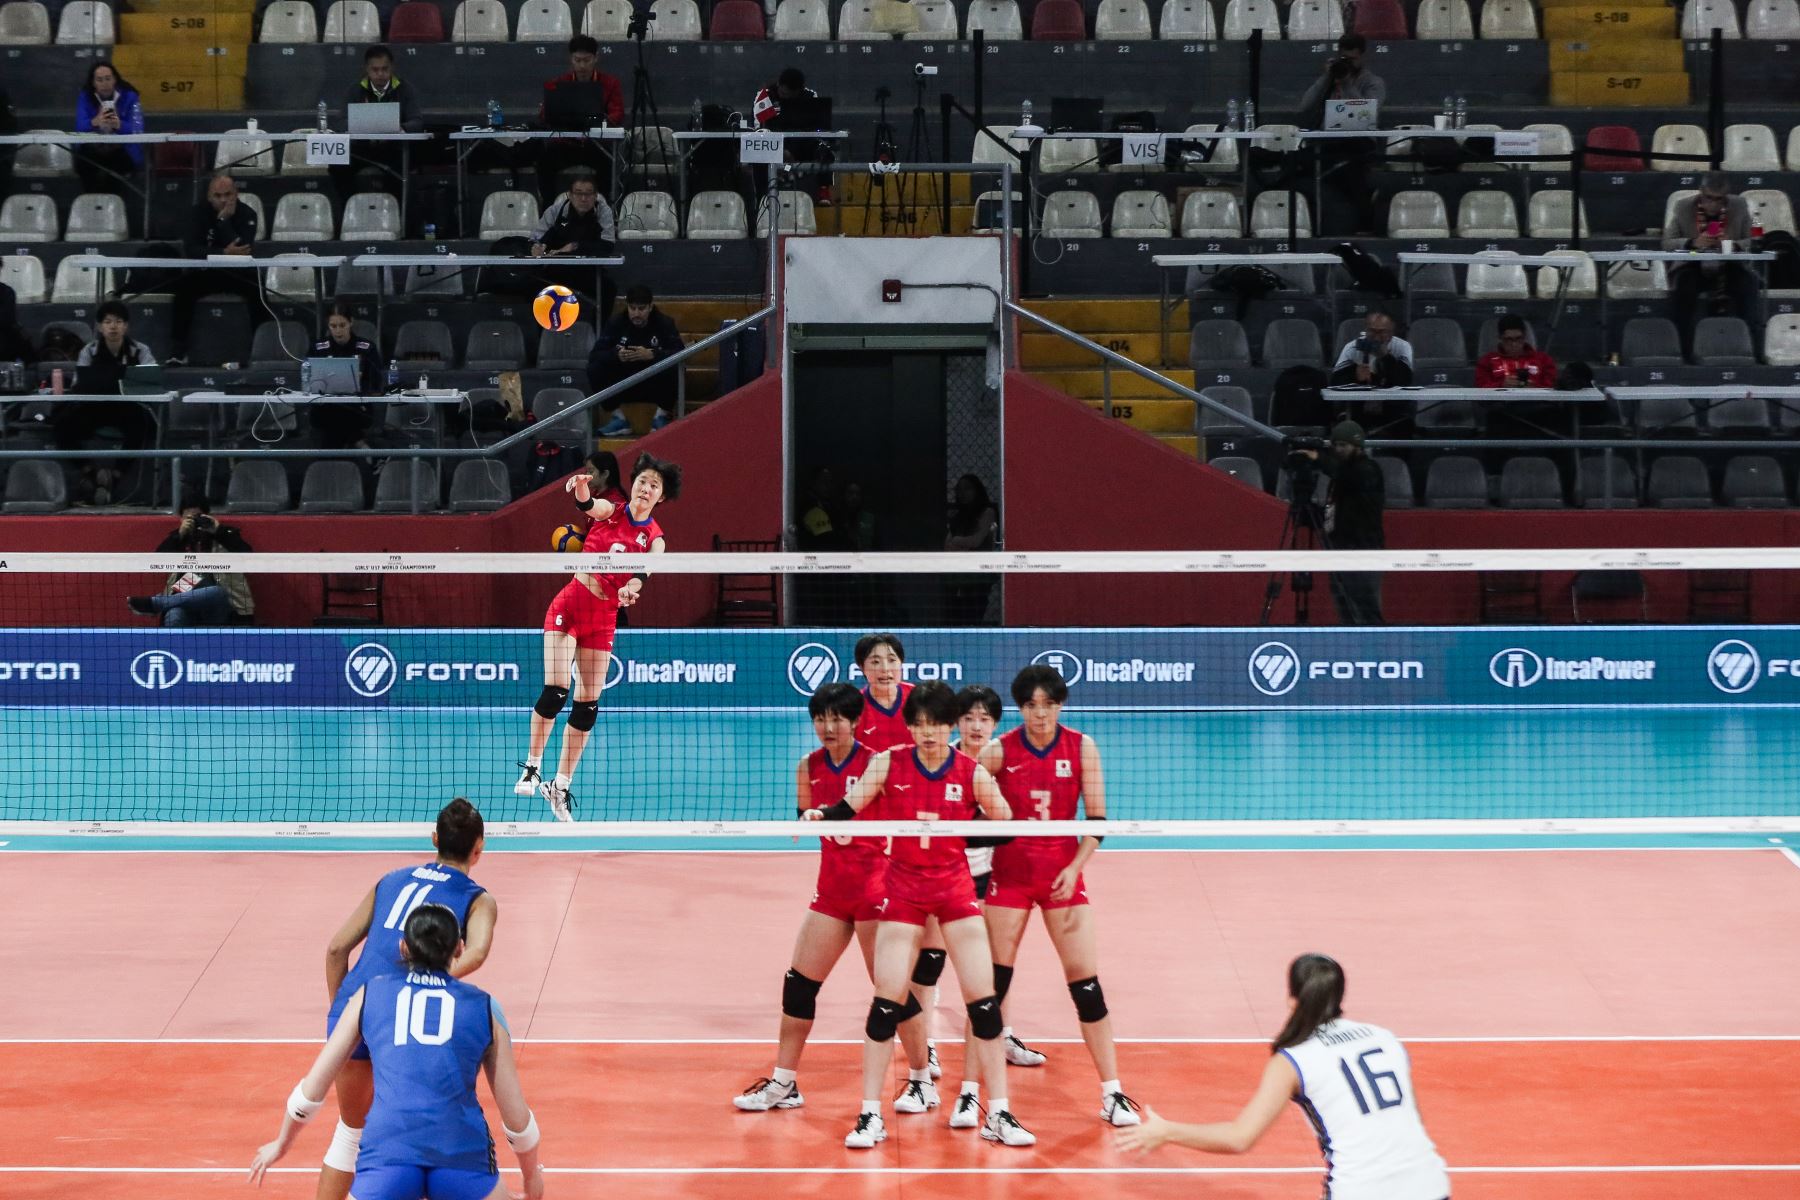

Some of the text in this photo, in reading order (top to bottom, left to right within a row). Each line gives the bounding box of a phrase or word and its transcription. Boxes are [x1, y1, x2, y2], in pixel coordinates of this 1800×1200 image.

[171, 18, 206, 29] S-08
[475, 47, 486, 55] 12
[923, 45, 934, 53] 19
[987, 45, 999, 53] 20
[1053, 45, 1064, 53] 21
[1118, 45, 1130, 53] 22
[1183, 45, 1195, 53] 23
[1376, 44, 1388, 52] 26
[160, 81, 194, 92] S-07
[1606, 77, 1642, 89] S-07
[311, 142, 346, 156] FIVB
[745, 140, 779, 152] PERU
[1130, 143, 1158, 158] VIS
[365, 246, 376, 254] 12
[435, 245, 447, 253] 13
[642, 245, 653, 253] 16
[711, 245, 722, 253] 17
[1138, 243, 1149, 251] 21
[1208, 243, 1220, 251] 22
[1277, 243, 1289, 251] 23
[144, 308, 153, 316] 11
[211, 308, 222, 317] 12
[204, 377, 215, 385] 14
[274, 377, 285, 385] 15
[488, 376, 499, 385] 18
[561, 376, 572, 384] 19
[1222, 442, 1234, 450] 21
[555, 615, 563, 626] 6
[186, 660, 296, 683] IncaPower
[405, 663, 520, 681] FOTON
[627, 660, 737, 683] IncaPower
[848, 662, 963, 681] FTON
[1086, 658, 1195, 682] IncaPower
[1308, 661, 1424, 679] FOTON
[1546, 656, 1656, 680] IncaPower
[1028, 790, 1052, 820] 3
[394, 985, 456, 1047] 10
[1338, 1048, 1403, 1115] 16
